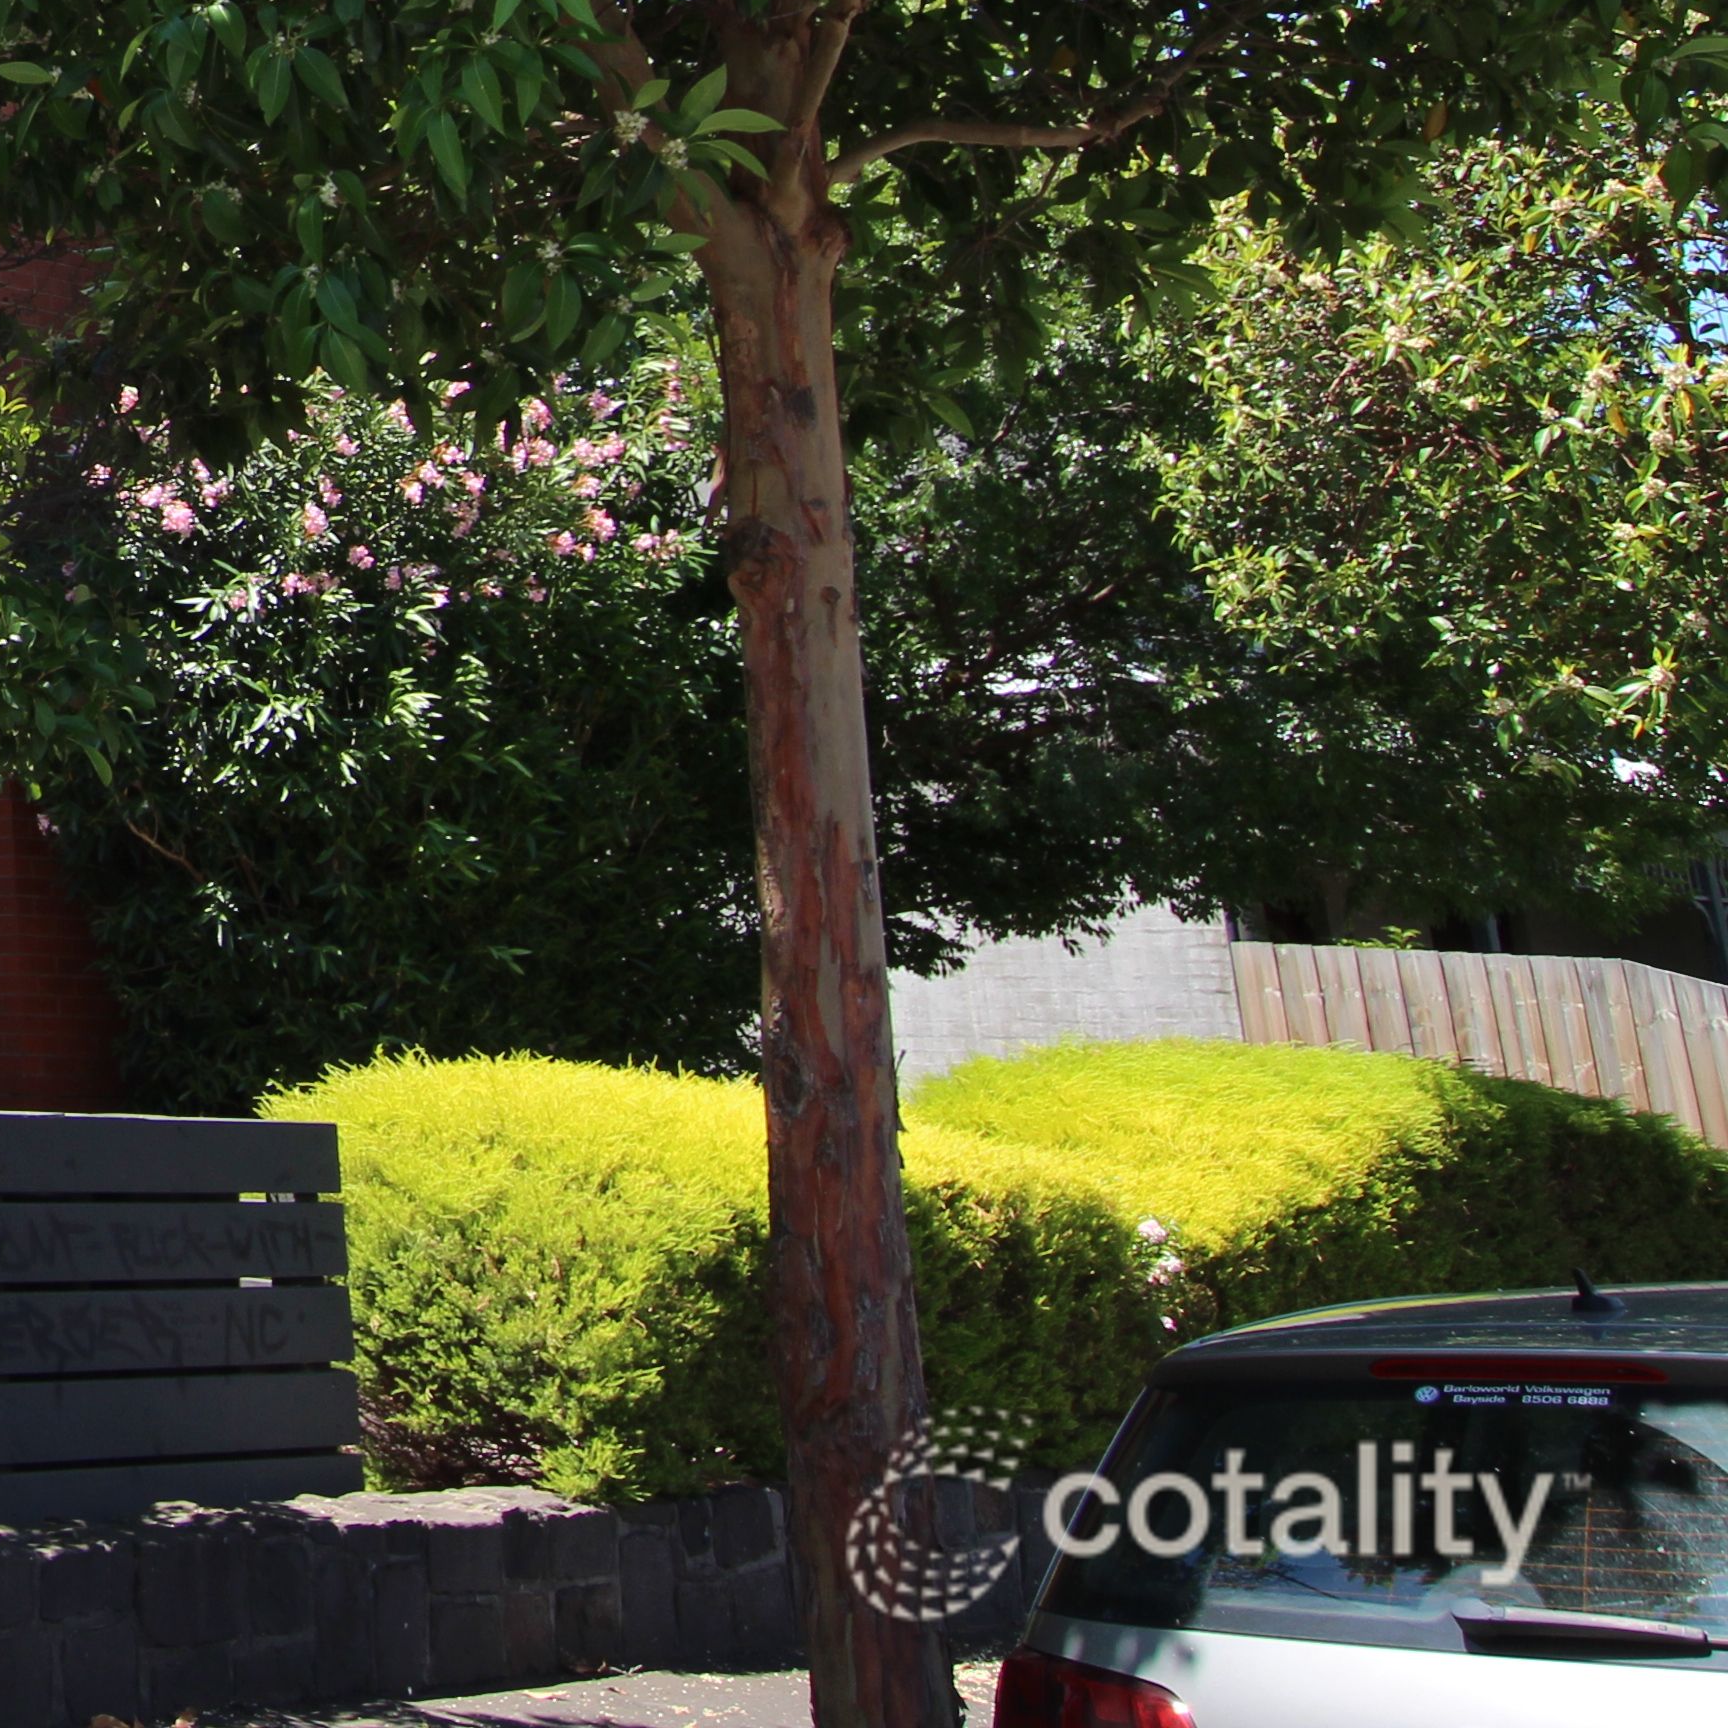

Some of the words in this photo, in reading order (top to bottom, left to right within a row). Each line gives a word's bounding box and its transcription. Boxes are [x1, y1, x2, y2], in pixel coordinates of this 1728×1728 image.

[1444, 1384, 1520, 1394] Barloworld
[1524, 1384, 1611, 1396] Volkswagen
[1453, 1394, 1507, 1404] Bayside
[1522, 1394, 1563, 1404] 8506
[1567, 1395, 1609, 1406] 6888
